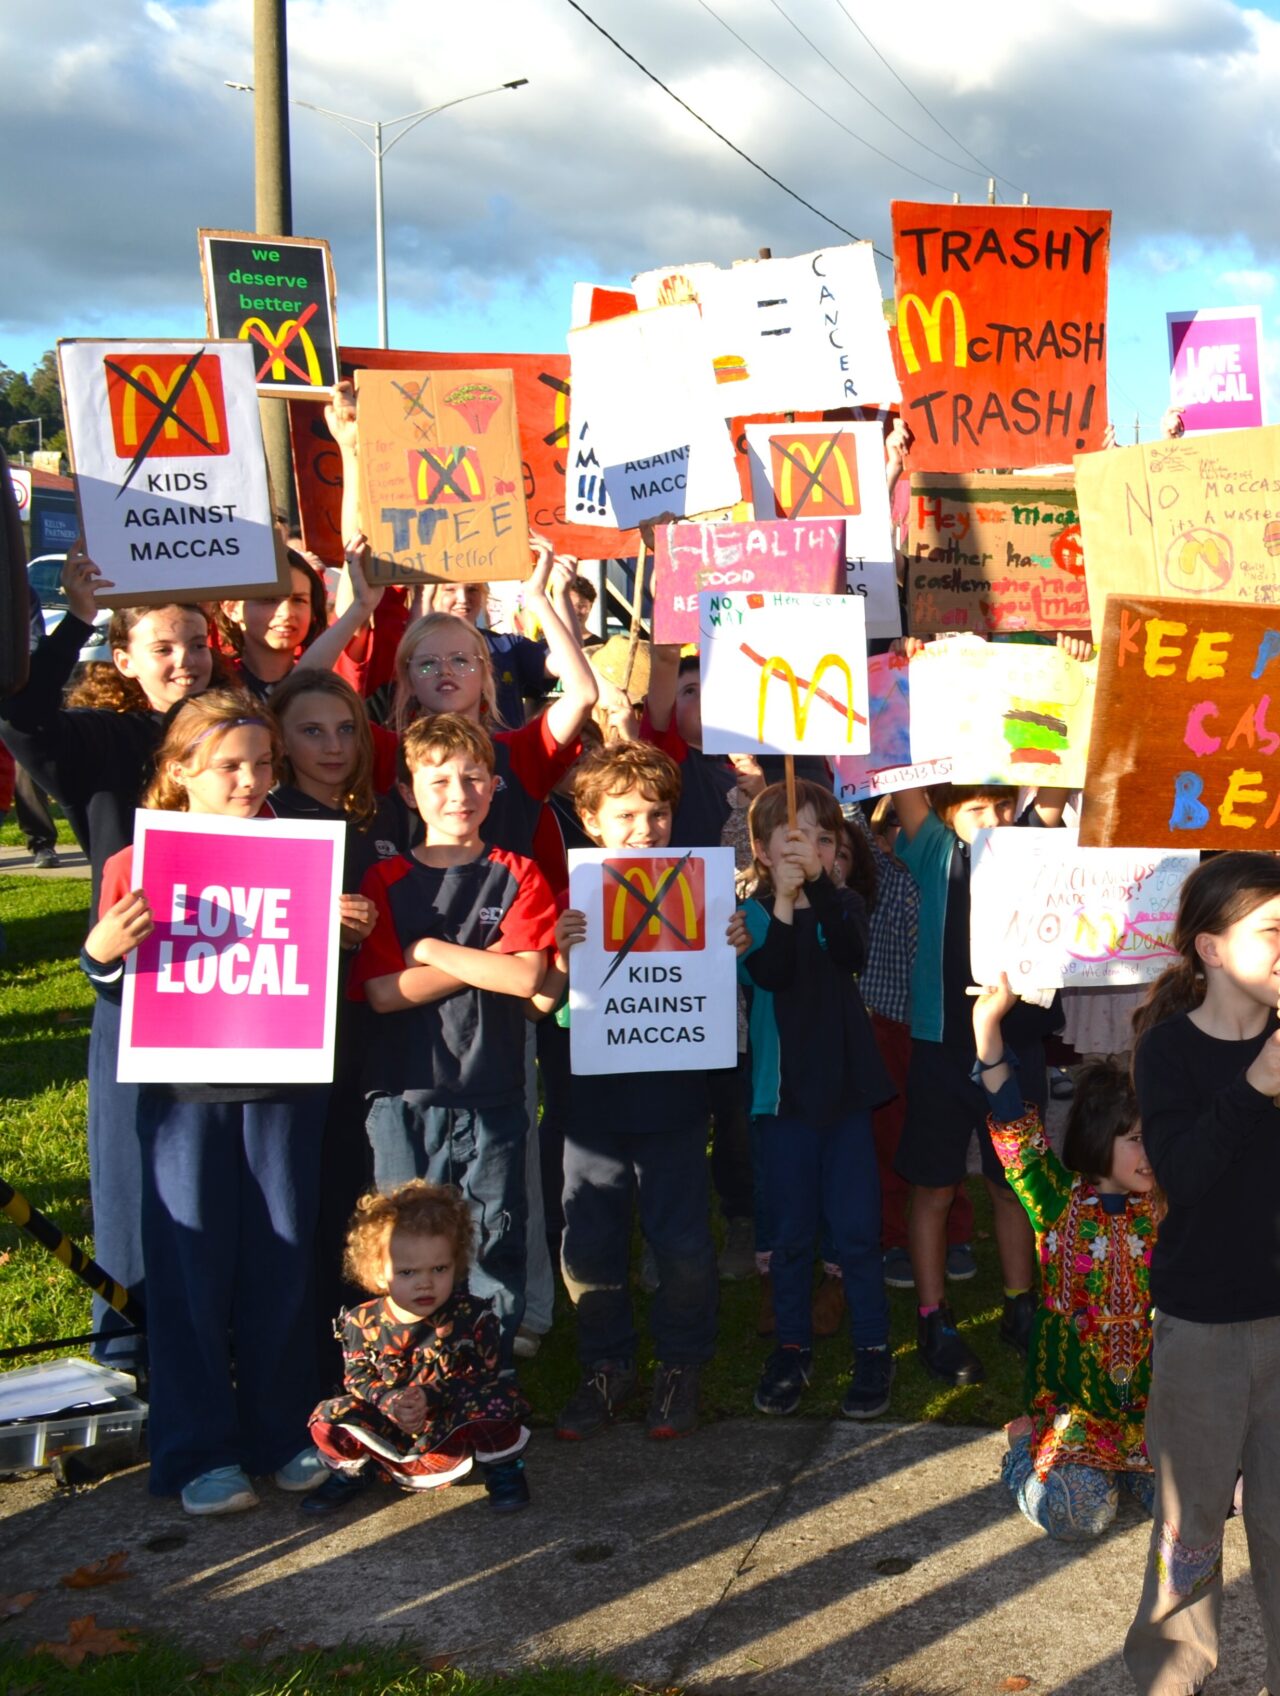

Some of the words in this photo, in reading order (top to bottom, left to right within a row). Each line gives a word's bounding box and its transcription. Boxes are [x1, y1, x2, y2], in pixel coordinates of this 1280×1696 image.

[251, 248, 281, 262] we
[900, 225, 1105, 276] TRASHY
[228, 269, 308, 289] deserve
[239, 293, 302, 313] better
[811, 254, 858, 398] CANCER
[909, 384, 1096, 449] TRASH!
[147, 472, 208, 492] KIDS
[124, 504, 237, 528] AGAINST
[917, 495, 971, 541] Hey
[1125, 482, 1180, 536] NO
[1204, 509, 1216, 525] A
[130, 537, 241, 561] MACCAS
[667, 522, 841, 572] HEALTHY
[914, 537, 993, 566] rather
[710, 596, 732, 612] NO
[169, 883, 291, 938] LOVE
[155, 941, 309, 996] LOCAL
[628, 966, 682, 984] KIDS
[603, 995, 707, 1015] AGAINST
[606, 1025, 706, 1046] MACCAS
